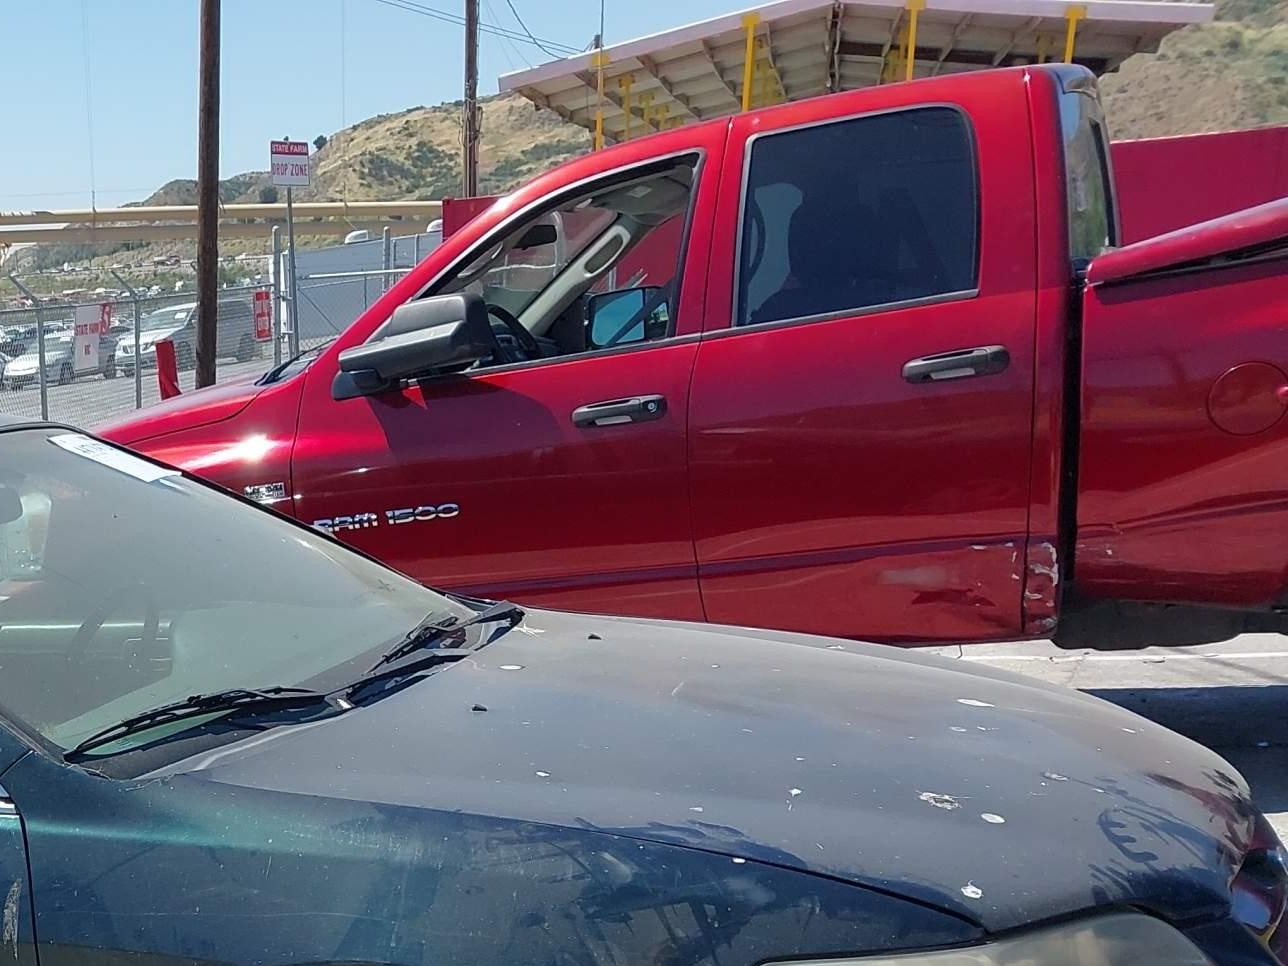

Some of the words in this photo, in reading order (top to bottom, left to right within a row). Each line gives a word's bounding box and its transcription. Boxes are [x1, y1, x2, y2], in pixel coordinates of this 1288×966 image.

[272, 144, 289, 153] STATE
[290, 144, 307, 153] FARM
[290, 164, 308, 176] ZONE
[385, 503, 460, 525] 1500
